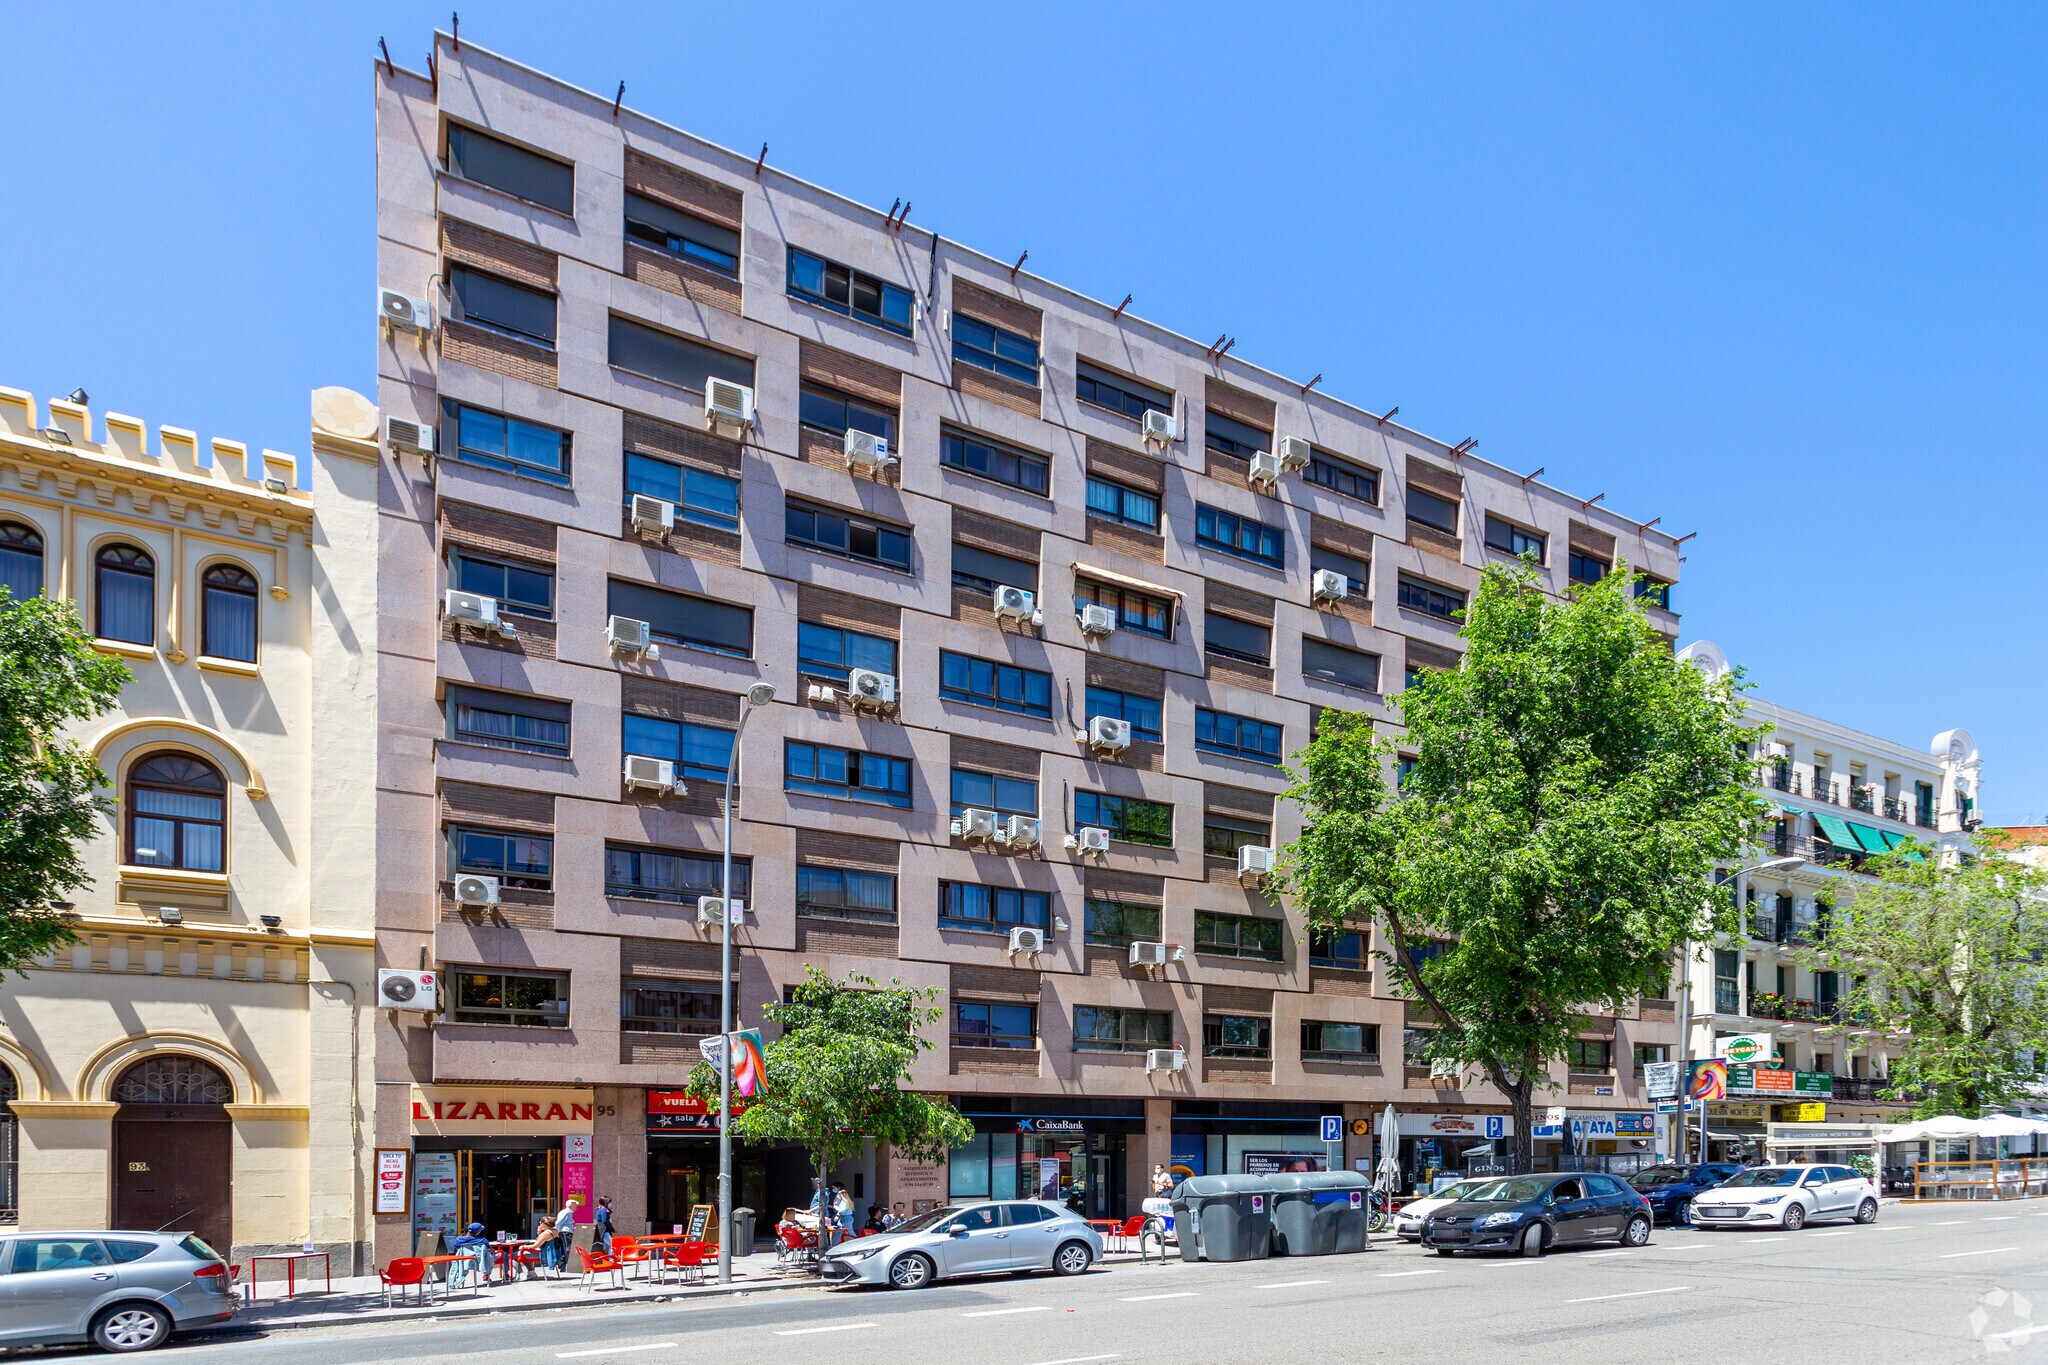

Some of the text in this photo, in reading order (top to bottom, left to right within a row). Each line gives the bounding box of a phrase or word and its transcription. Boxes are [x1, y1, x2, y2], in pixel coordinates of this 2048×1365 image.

[1723, 1045, 1762, 1054] REYCASA
[664, 1098, 698, 1107] VUELA
[412, 1102, 593, 1121] LIZARRAN
[597, 1106, 615, 1117] 95
[675, 1113, 694, 1121] sala
[696, 1114, 710, 1128] 4
[1036, 1119, 1084, 1130] CaixaBank
[1327, 1118, 1336, 1138] P
[1490, 1117, 1498, 1136] P
[1475, 1165, 1505, 1173] GINOS
